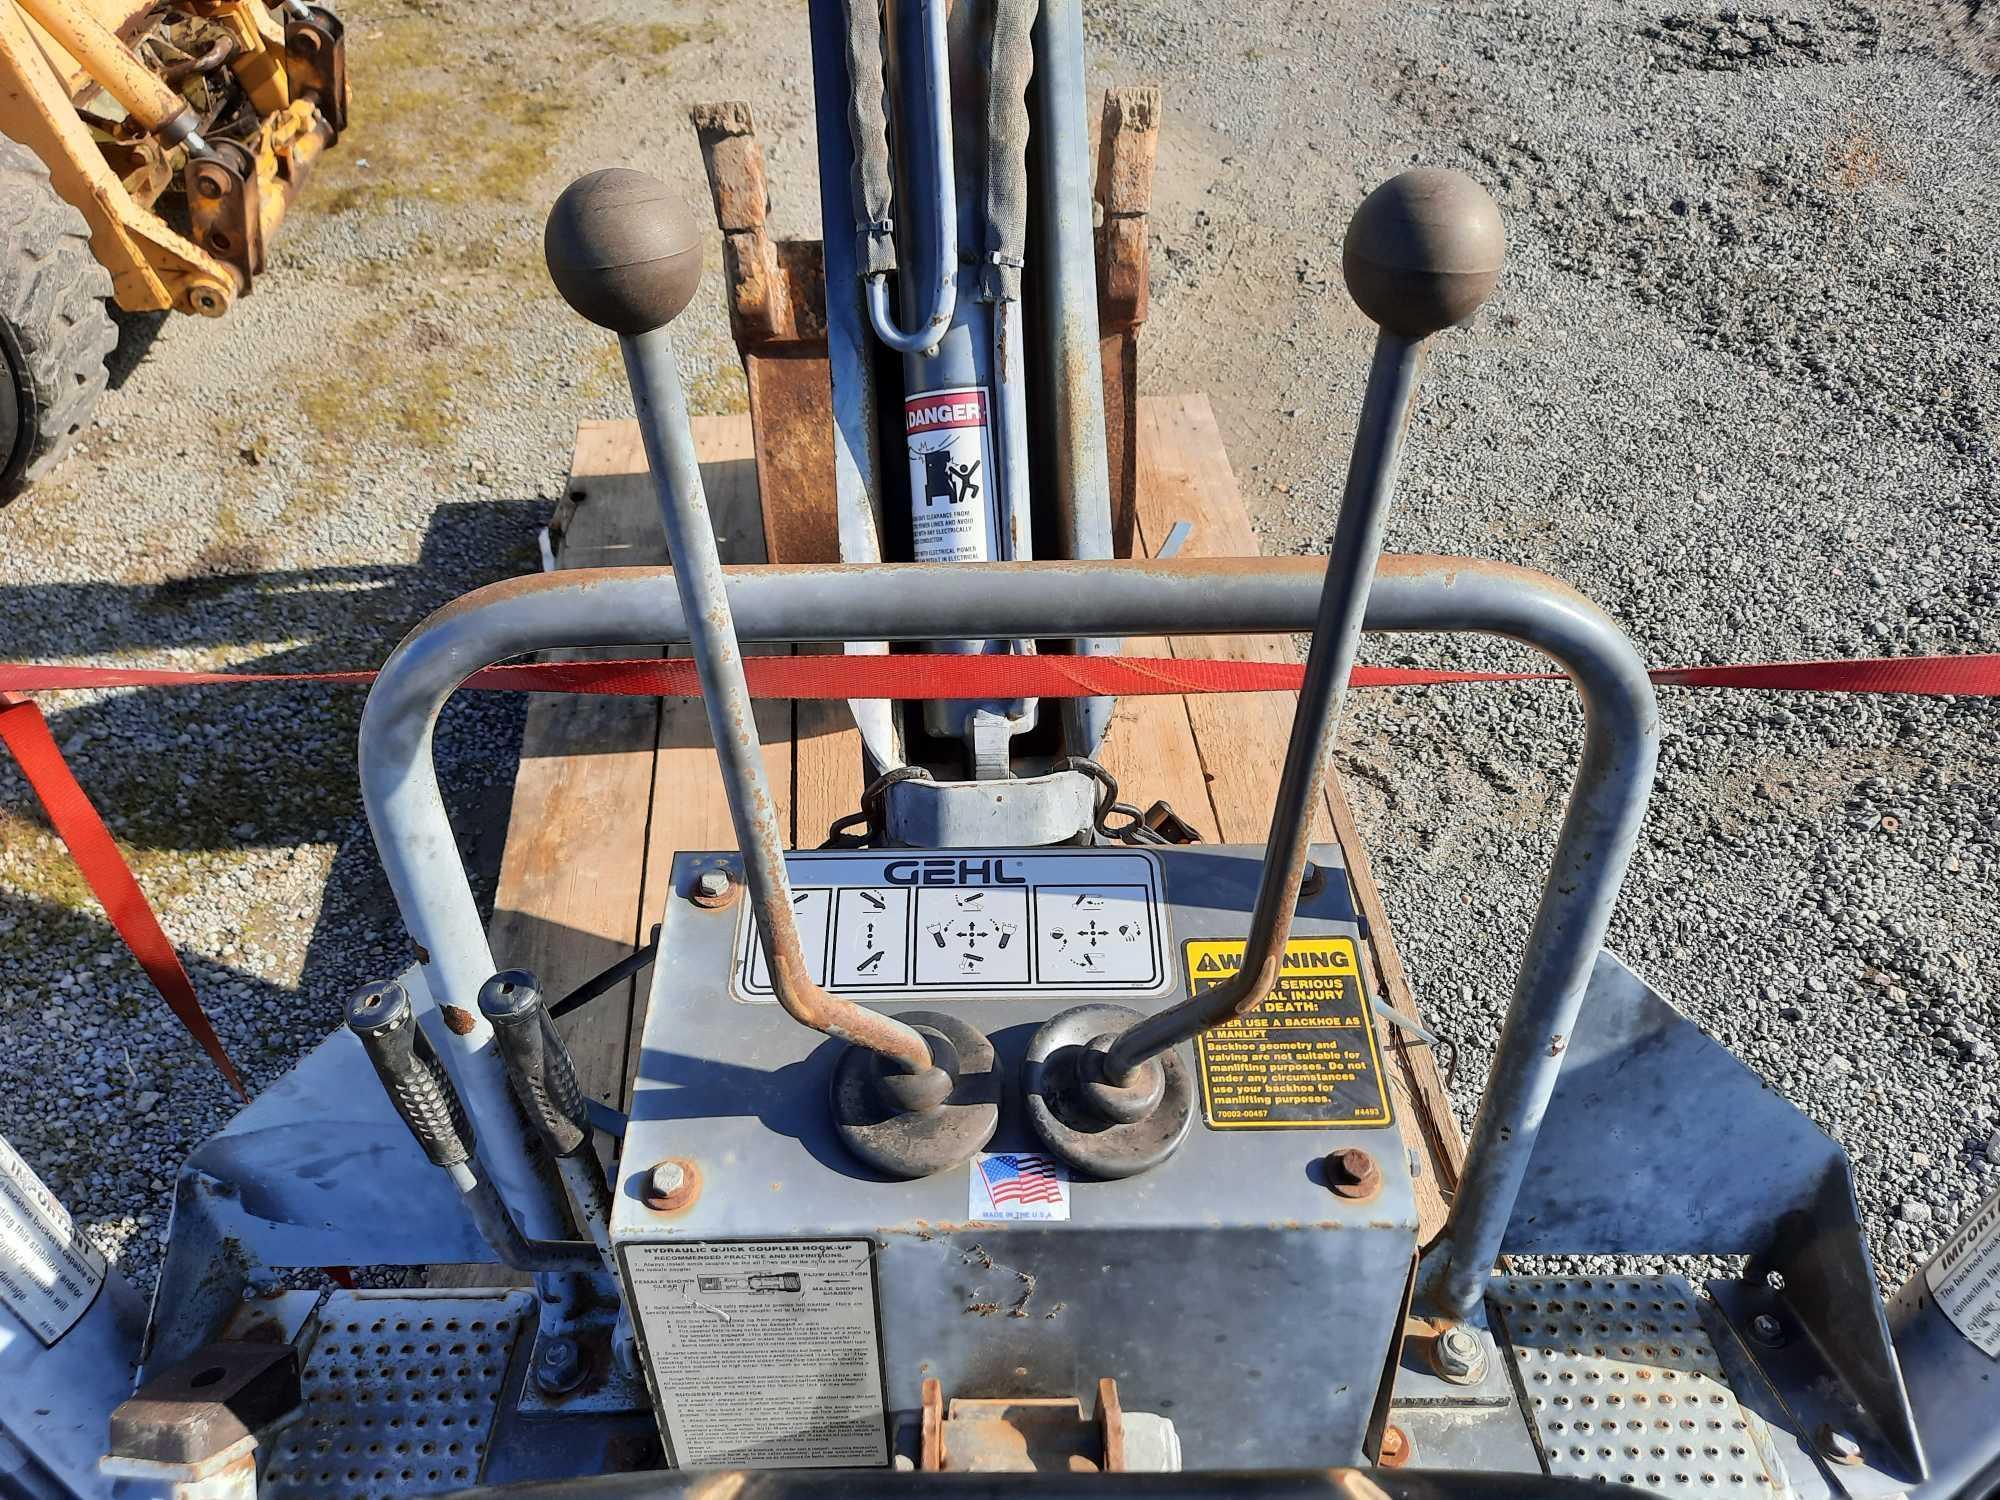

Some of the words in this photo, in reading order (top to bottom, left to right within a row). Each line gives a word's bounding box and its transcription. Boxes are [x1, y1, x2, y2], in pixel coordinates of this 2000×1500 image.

[909, 403, 981, 427] DANGER
[945, 519, 956, 527] AND
[884, 859, 1026, 885] GEHL
[1218, 951, 1350, 970] WNING
[1280, 979, 1344, 990] SERIOUS
[1291, 989, 1345, 1000] INJURY
[1265, 1002, 1320, 1013] DEATH:
[1246, 1018, 1269, 1028] USE
[1273, 1017, 1283, 1027] A
[1285, 1016, 1342, 1027] BACKHOE
[1345, 1016, 1361, 1026] AS
[1206, 1030, 1215, 1039] A
[1217, 1029, 1268, 1039] MANLIFT
[1206, 1041, 1257, 1052] Backhoe
[1259, 1041, 1313, 1053] geometry
[1316, 1040, 1337, 1050] and
[1208, 1052, 1249, 1063] valving
[1251, 1053, 1271, 1062] are
[1274, 1052, 1293, 1061] not
[1296, 1051, 1341, 1061] suitable
[1344, 1051, 1361, 1060] for
[1210, 1062, 1267, 1073] manlifting
[1269, 1063, 1326, 1074] purposes.
[1329, 1062, 1344, 1071] Do
[1347, 1062, 1366, 1071] not
[1211, 1073, 1244, 1084] under
[1247, 1075, 1268, 1085] any
[1271, 1073, 1356, 1082] circumstances
[1213, 1086, 1234, 1095] use
[1236, 1085, 1262, 1096] your
[1265, 1084, 1315, 1093] backhoe
[1318, 1083, 1335, 1093] for
[1214, 1095, 1272, 1105] manlifting
[1275, 1095, 1332, 1106] purposes.
[3, 1184, 33, 1219] backhoe
[33, 1215, 57, 1245] bucket
[62, 1249, 88, 1279] capable
[86, 1275, 96, 1287] of
[1941, 1198, 2000, 1271] IMPORT
[654, 1254, 721, 1262] RECOMMENDED
[1953, 1253, 1983, 1286] backhoe
[1952, 1277, 1991, 1317] contacting
[53, 1296, 70, 1312] will
